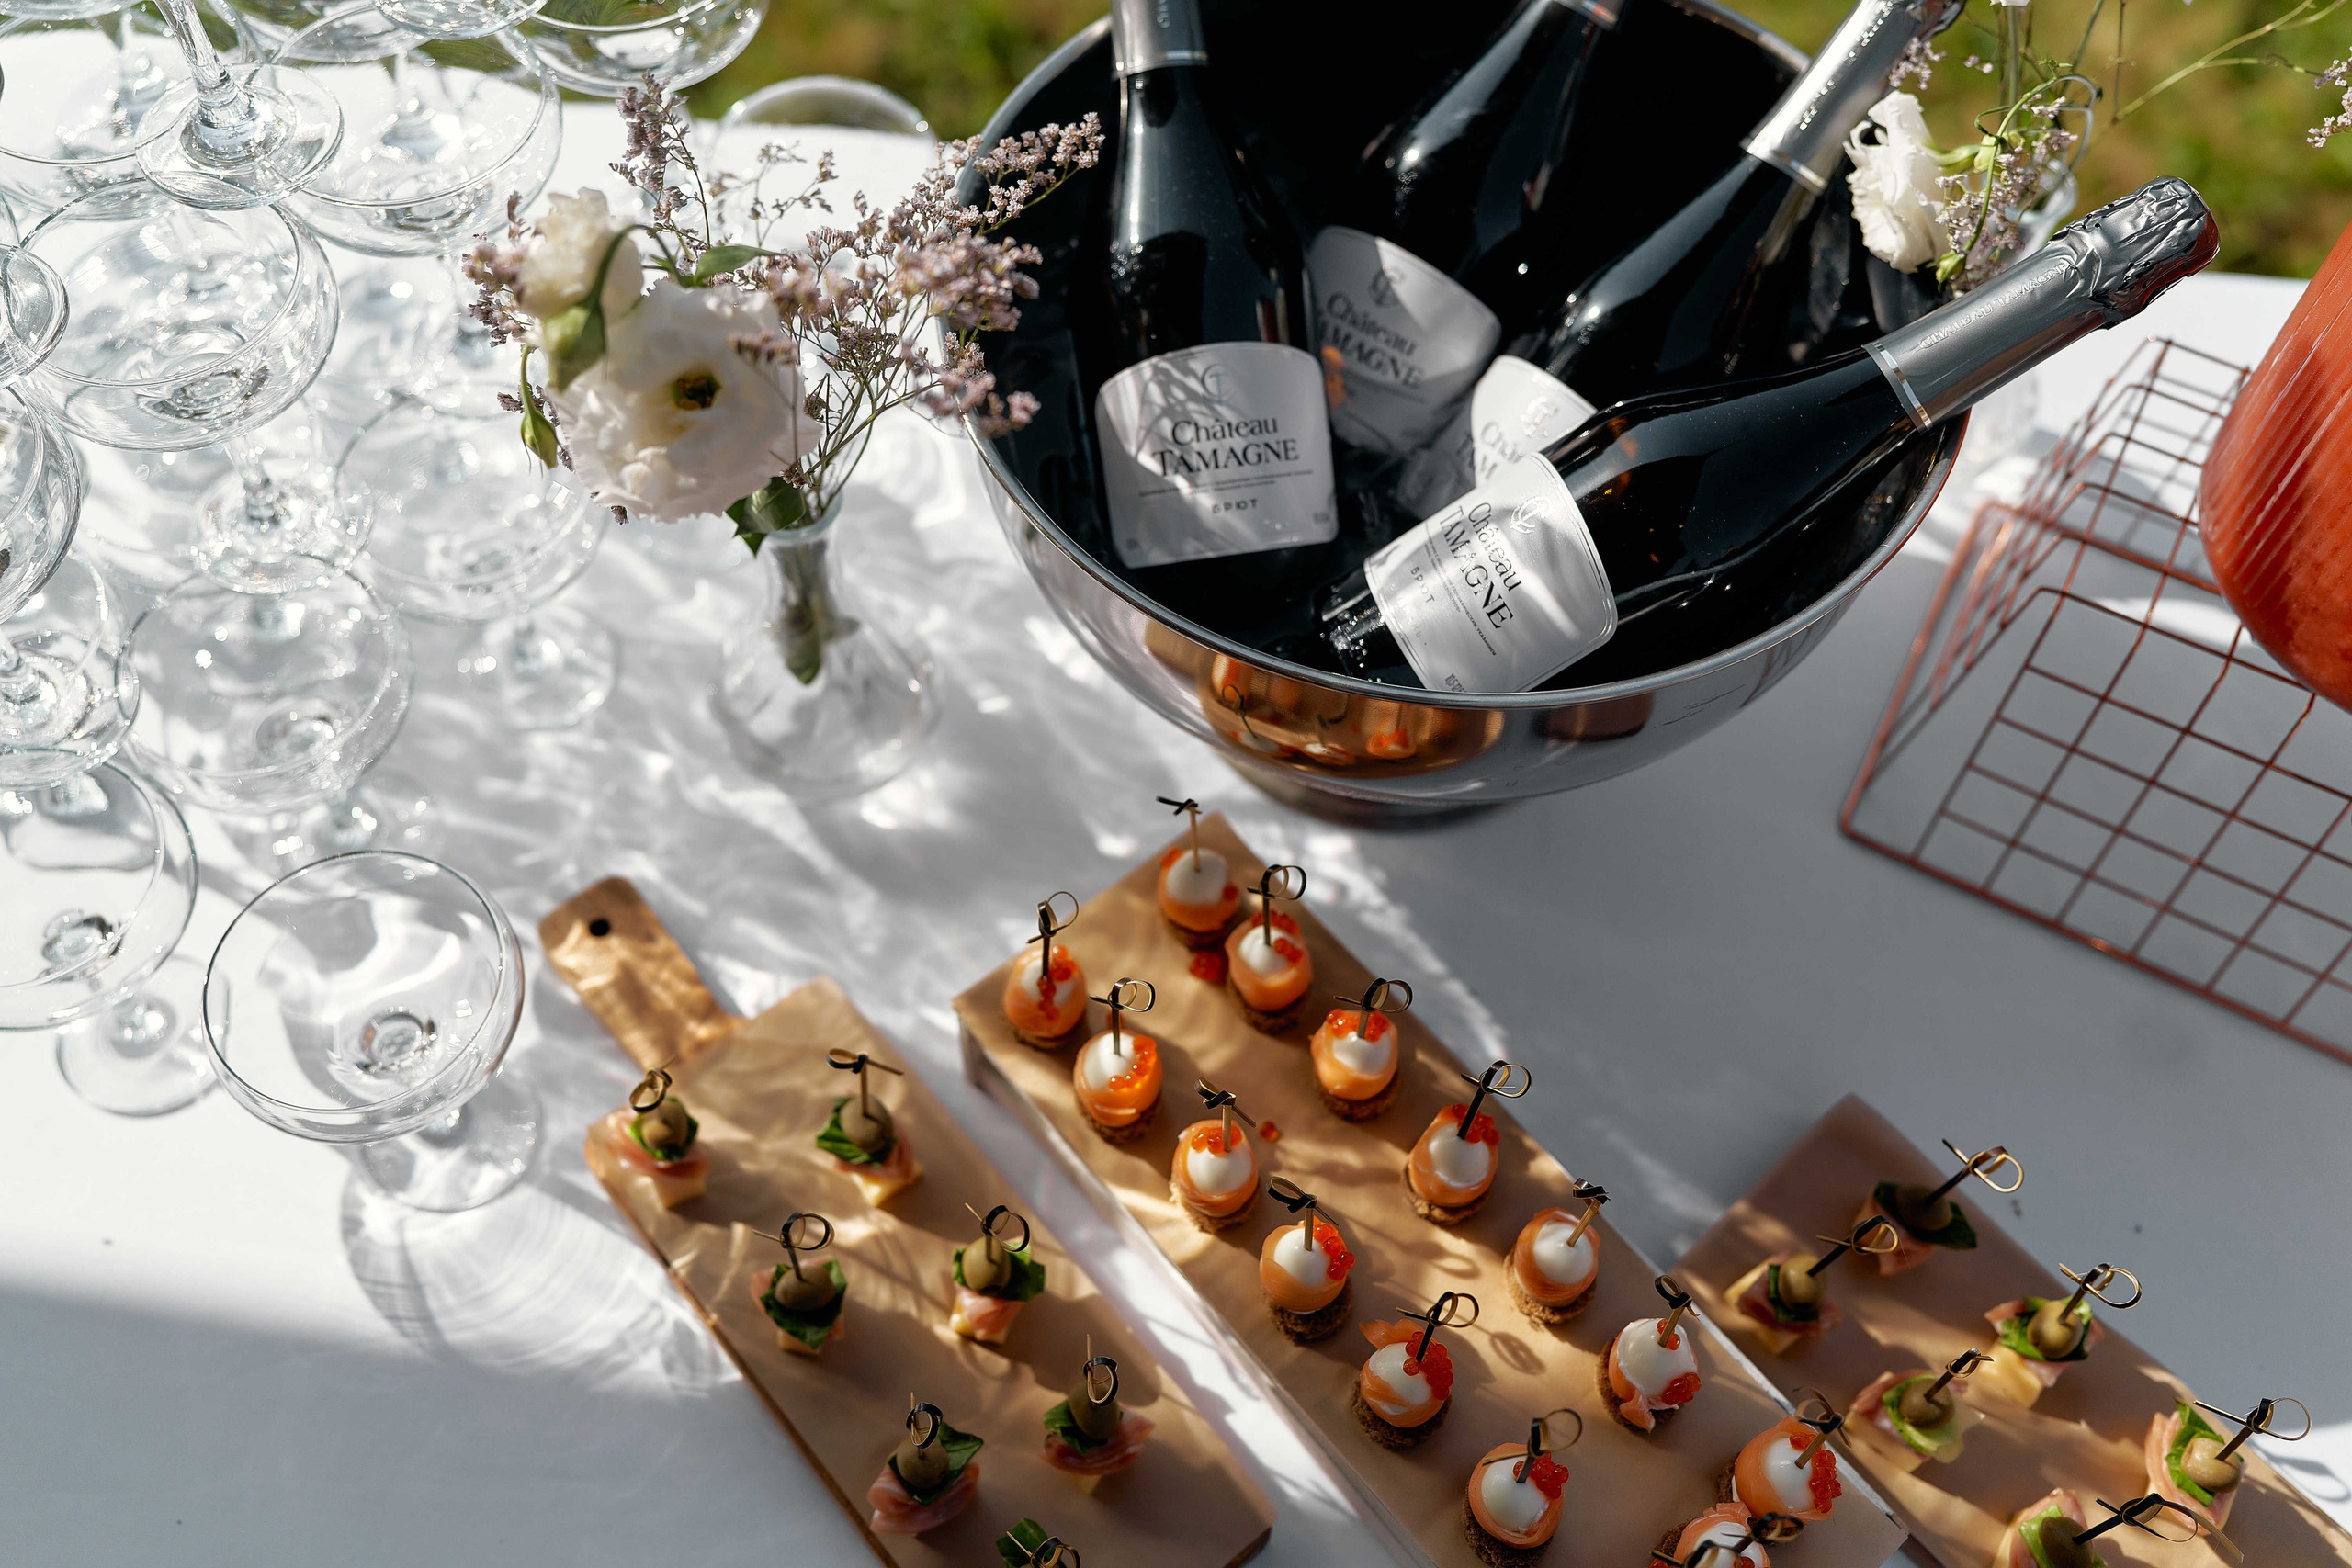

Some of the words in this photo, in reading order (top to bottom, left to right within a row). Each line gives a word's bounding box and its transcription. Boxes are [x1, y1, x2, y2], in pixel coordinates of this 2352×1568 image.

[1171, 416, 1279, 446] Château
[1151, 439, 1300, 478] TAMAGNE
[1467, 502, 1522, 592] Château
[1410, 566, 1435, 603] БРЮТ
[1440, 505, 1514, 629] TAMAGNE
